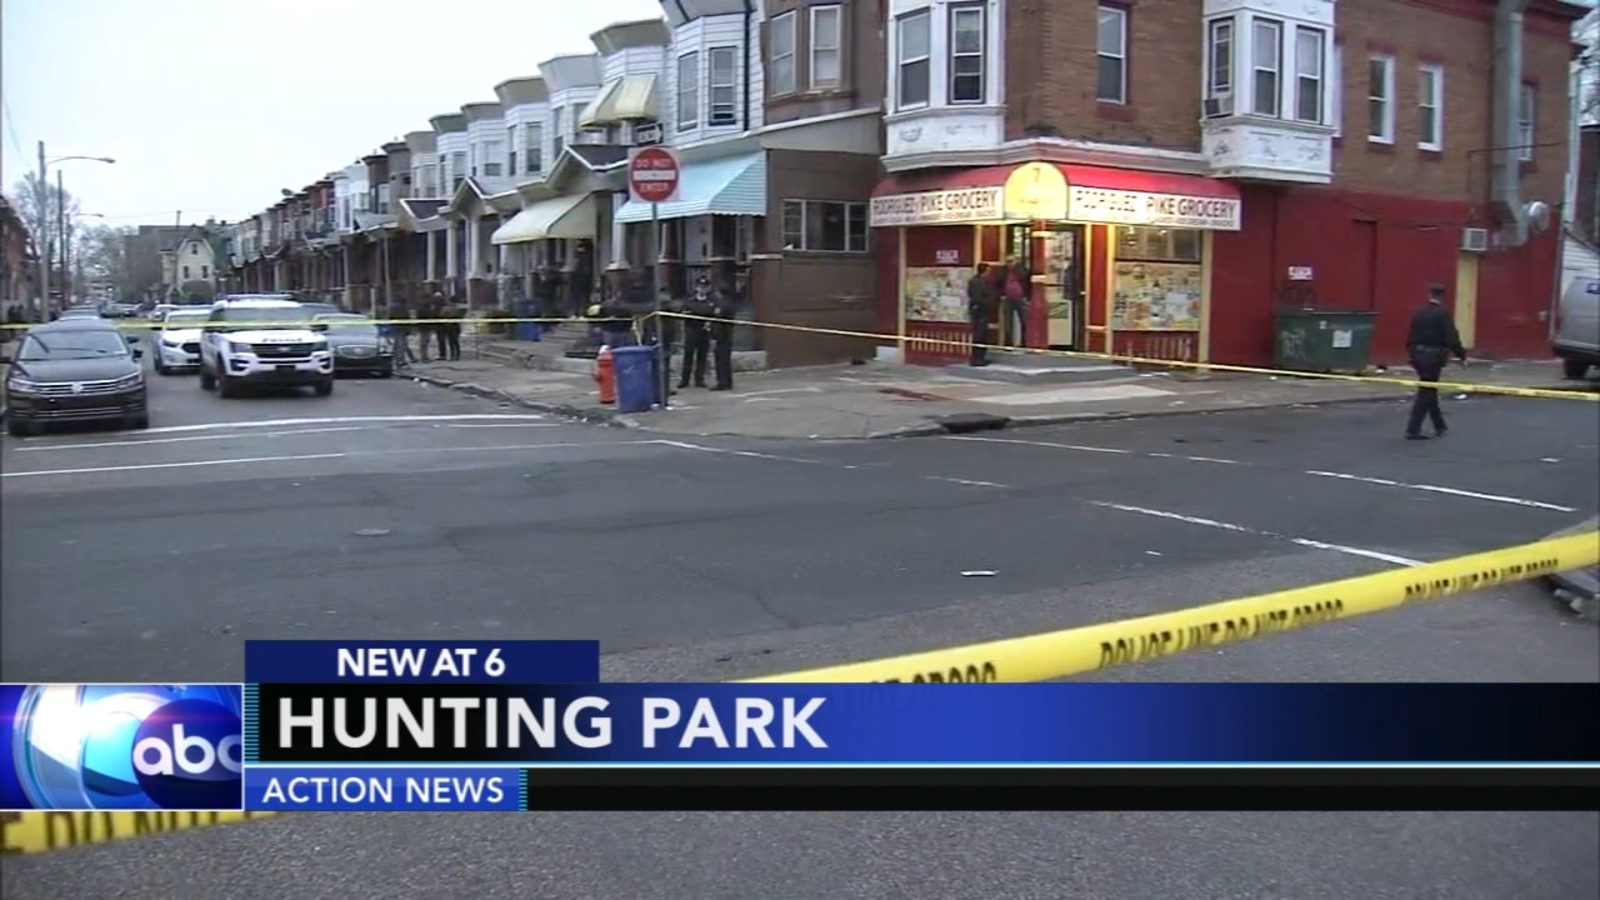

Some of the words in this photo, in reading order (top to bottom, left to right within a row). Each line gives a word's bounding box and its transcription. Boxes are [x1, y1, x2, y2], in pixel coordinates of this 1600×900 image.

[920, 194, 943, 212] PIKE
[945, 189, 997, 211] GROCERY
[1147, 196, 1176, 216] PIKE
[1177, 197, 1237, 219] GROCERY
